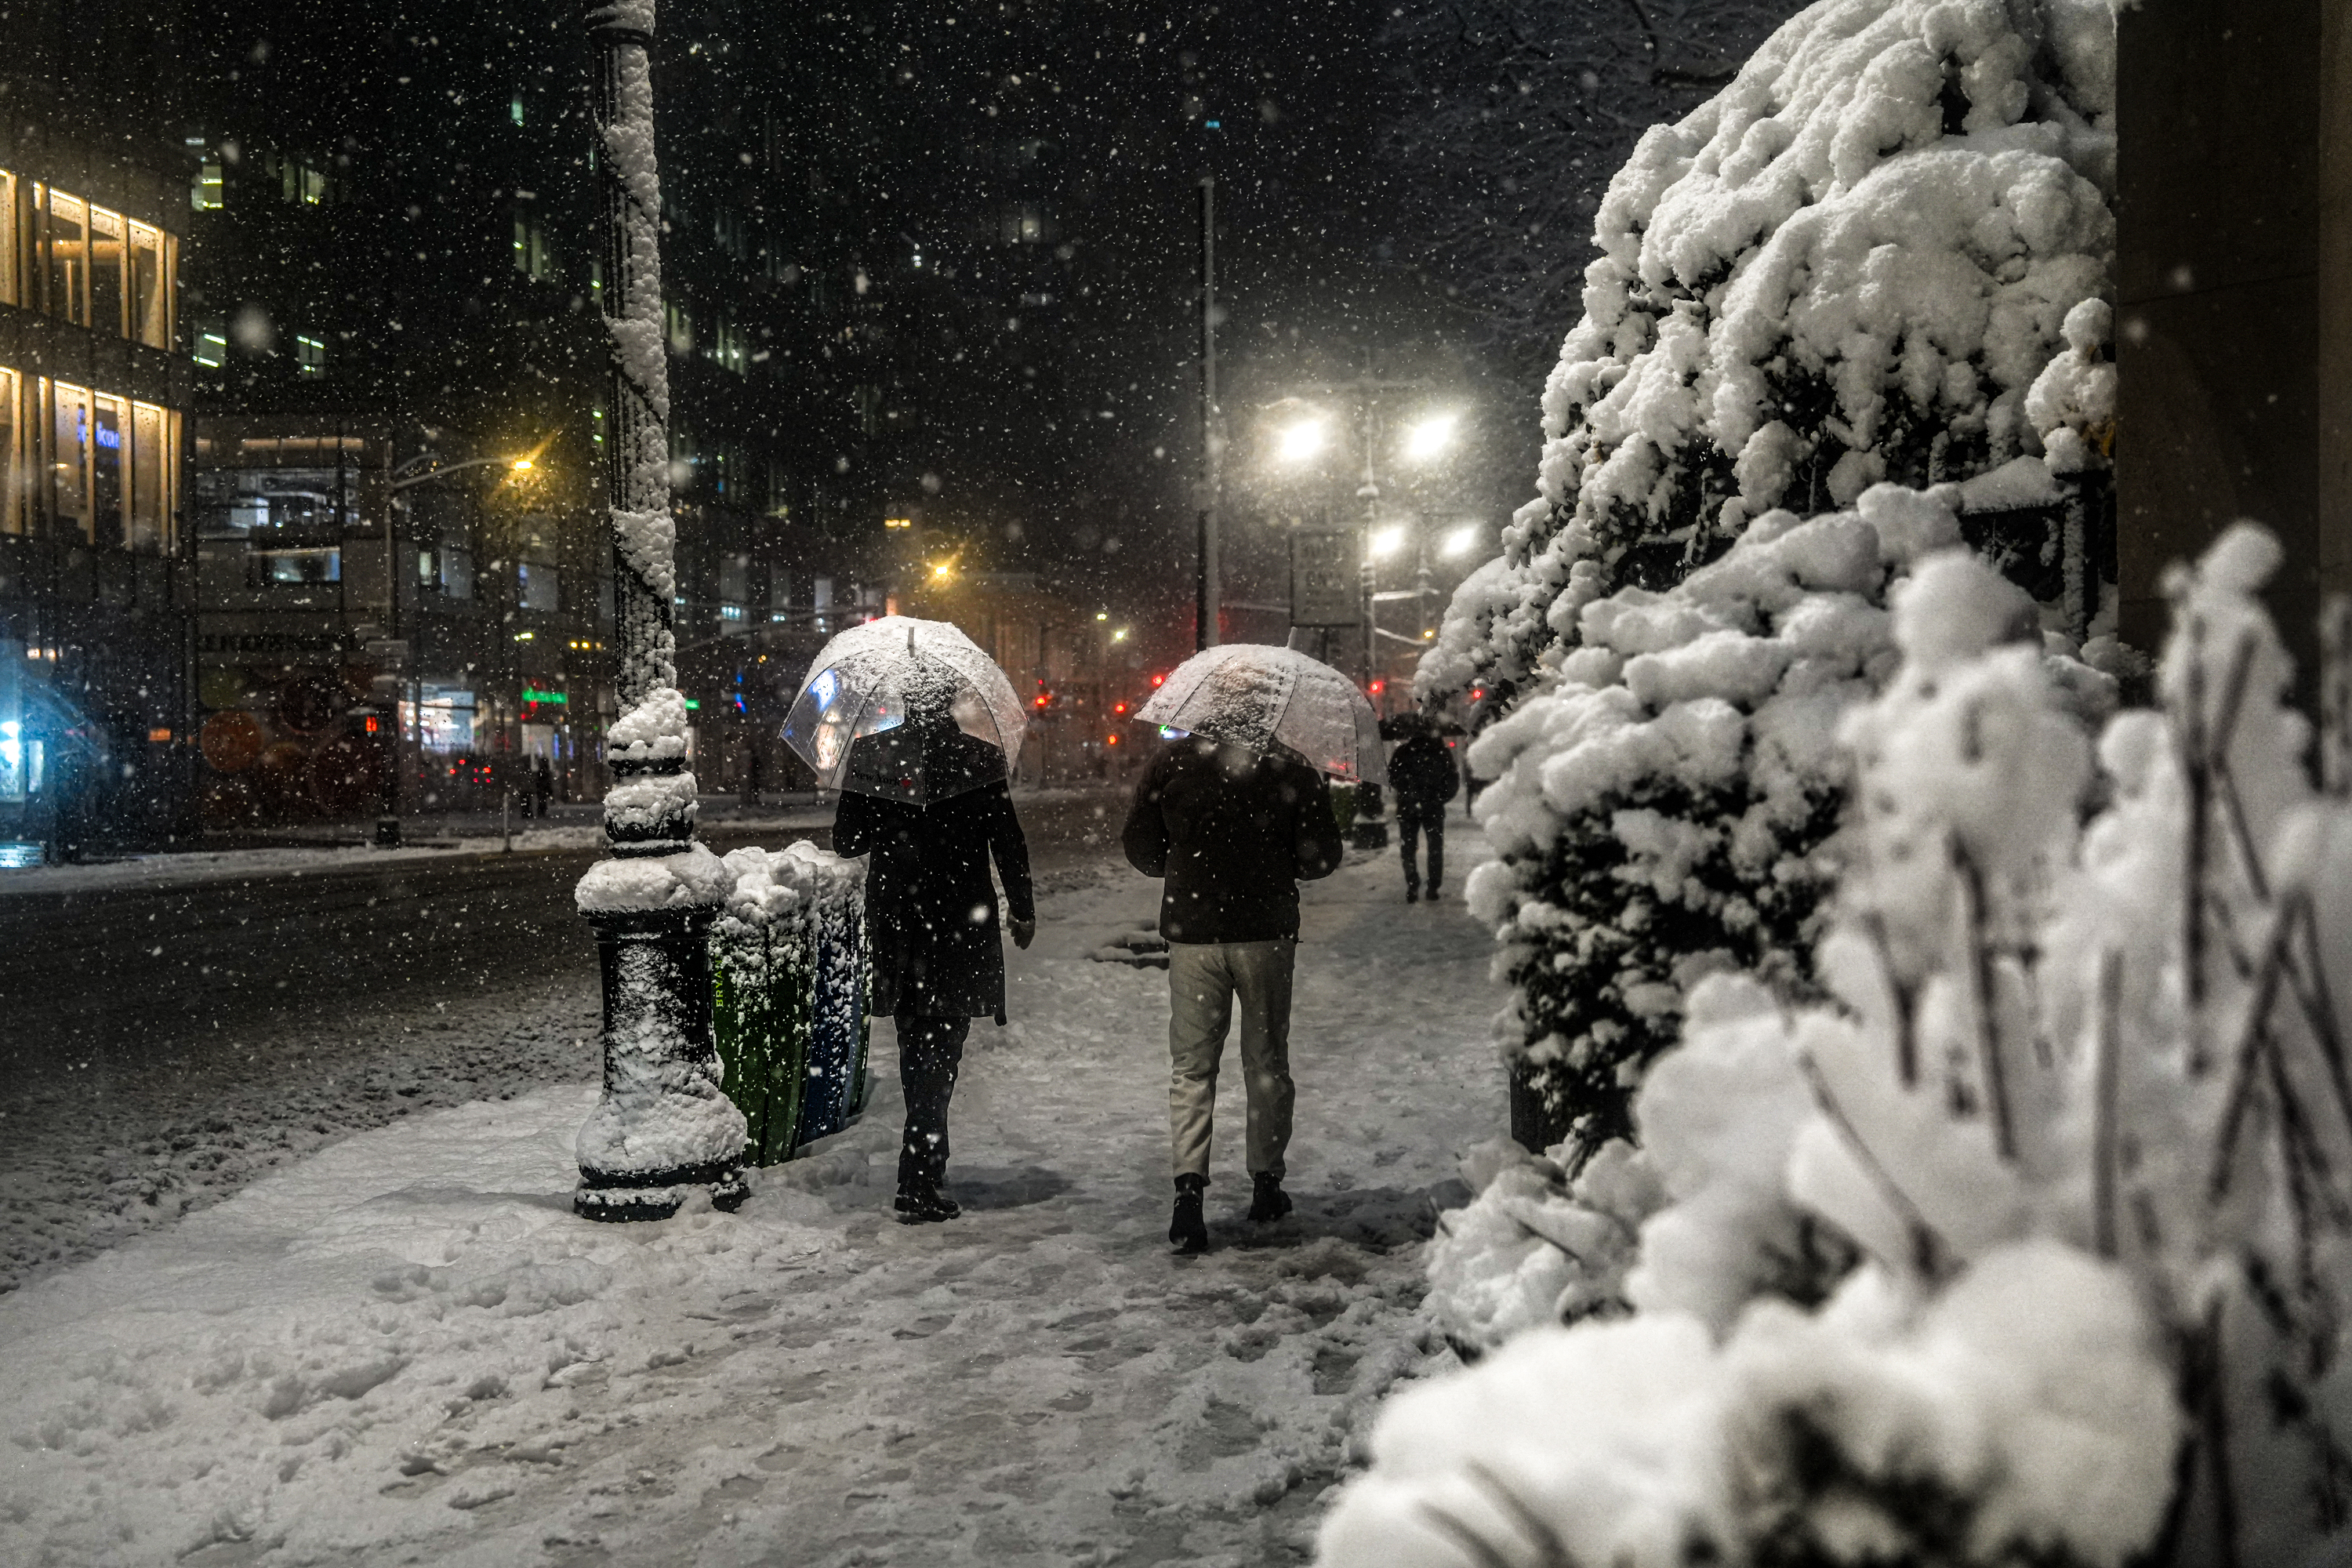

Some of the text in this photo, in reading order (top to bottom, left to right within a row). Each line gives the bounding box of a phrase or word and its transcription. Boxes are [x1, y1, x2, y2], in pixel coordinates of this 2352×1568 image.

[851, 769, 900, 786] New York
[714, 954, 724, 1007] BRYAN
